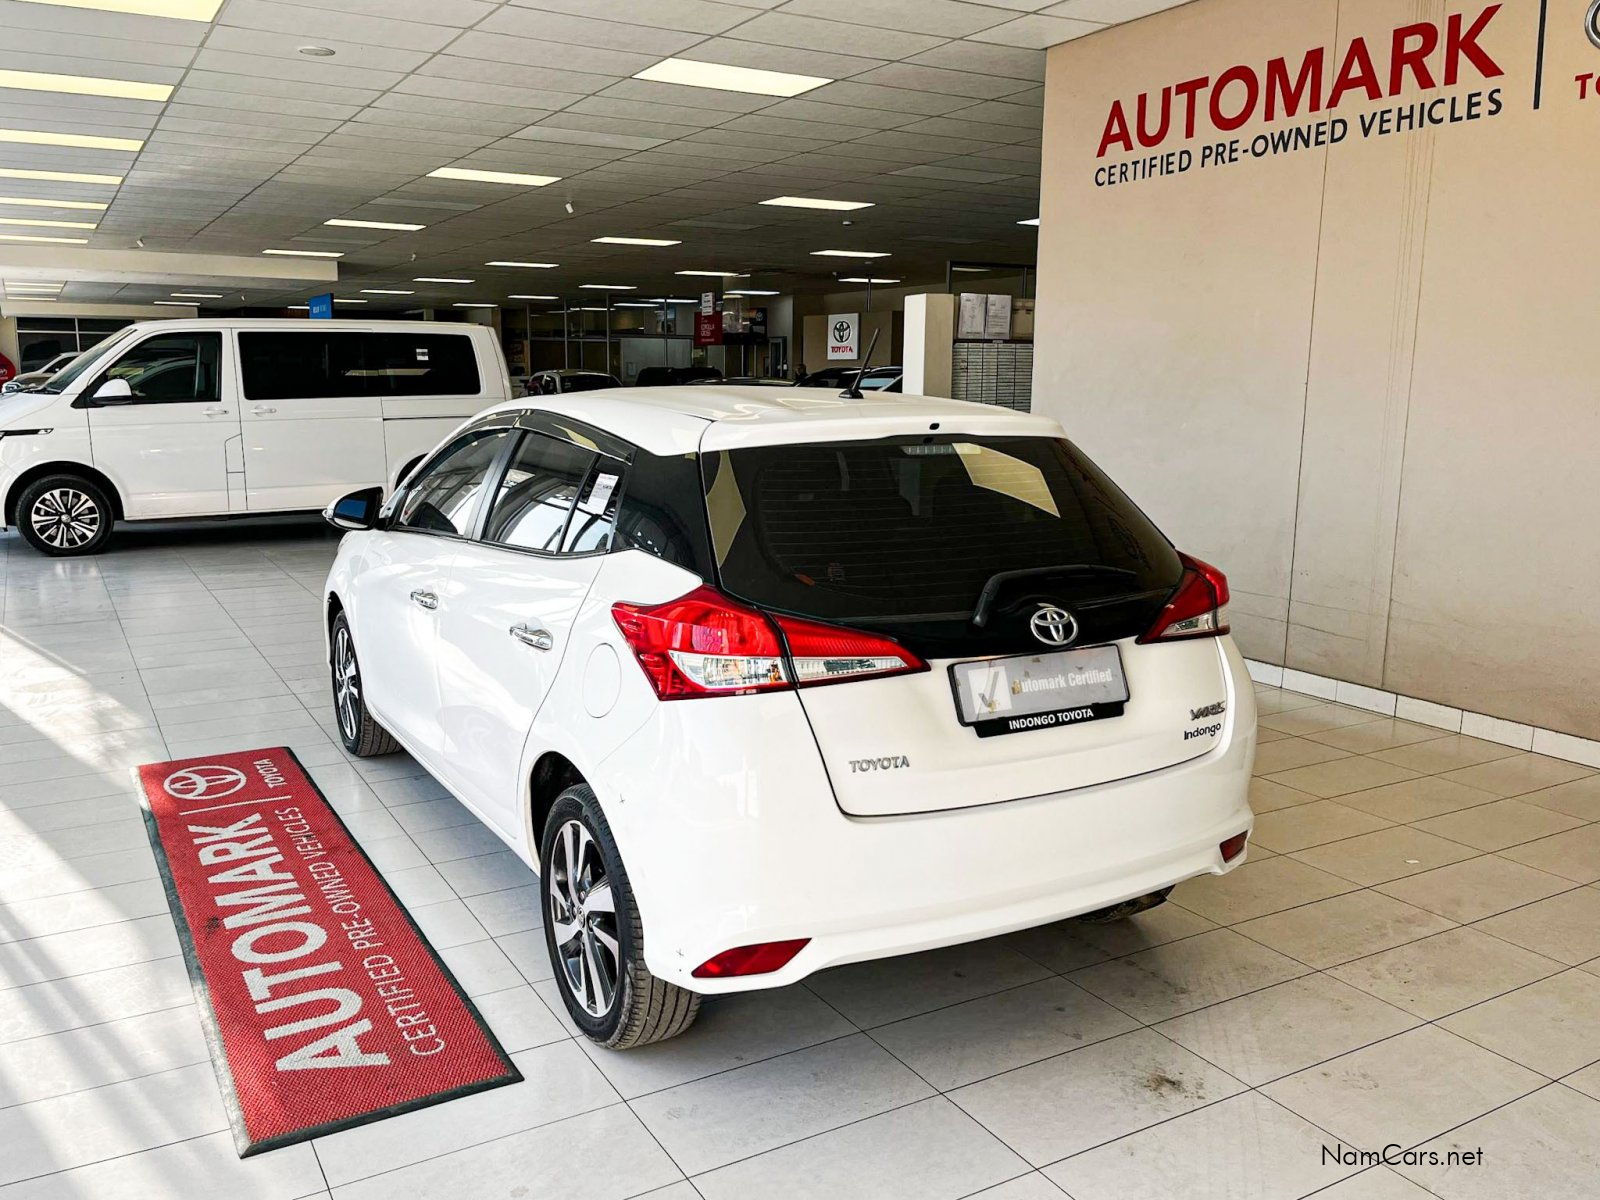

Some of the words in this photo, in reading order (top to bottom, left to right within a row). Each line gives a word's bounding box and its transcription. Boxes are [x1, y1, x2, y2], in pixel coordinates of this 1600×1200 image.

[1096, 3, 1505, 158] AUTOMARK
[1574, 72, 1600, 100] T
[1094, 149, 1193, 187] CERTIFIED
[1200, 118, 1348, 168] PRE-OWNED
[1359, 88, 1503, 138] VEHICLES
[831, 345, 853, 354] TOYOTA
[1067, 668, 1113, 688] Certified
[1008, 713, 1056, 731] INDONGO
[1056, 708, 1095, 723] TOYOTA
[1184, 723, 1221, 740] Indongo
[253, 759, 288, 788] TOYOTA
[849, 755, 910, 773] TOYOTA
[273, 806, 325, 861] VEHICLES
[311, 861, 384, 951] PRE-OWNED
[187, 812, 391, 1073] AUTOMARK
[363, 954, 446, 1057] CERTIFIED
